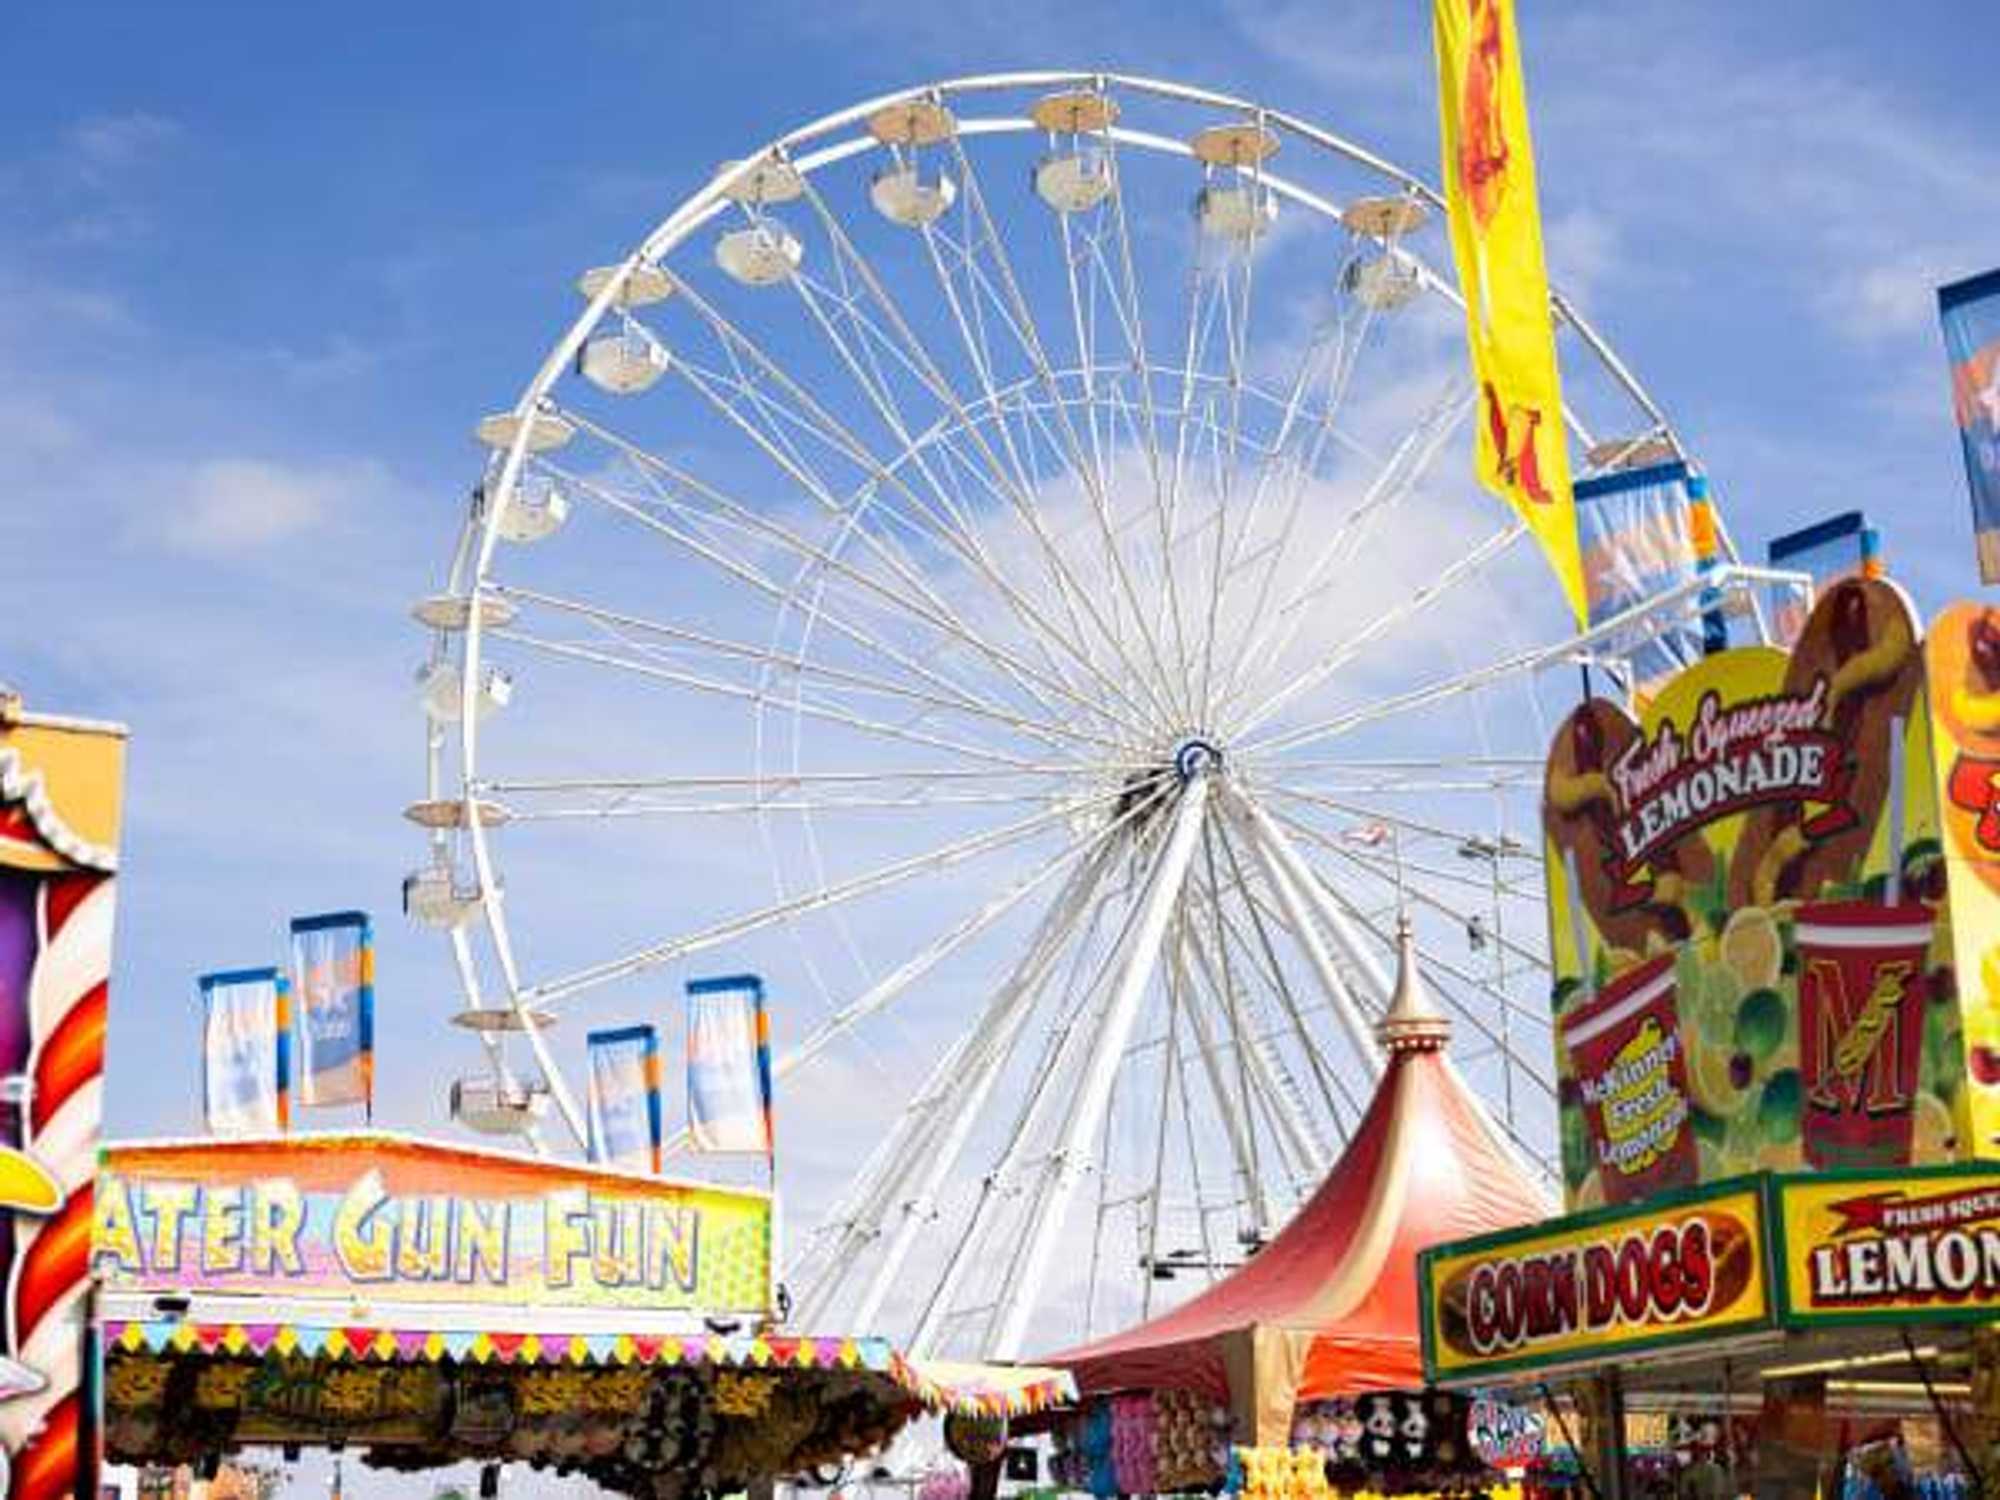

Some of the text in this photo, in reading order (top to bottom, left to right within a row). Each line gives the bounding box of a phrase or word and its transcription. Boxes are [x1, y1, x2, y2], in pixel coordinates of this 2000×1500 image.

[1612, 727, 1680, 812] Fresh
[1620, 745, 1826, 860] LEMONADE
[1467, 1216, 1714, 1354] CORN DOGS
